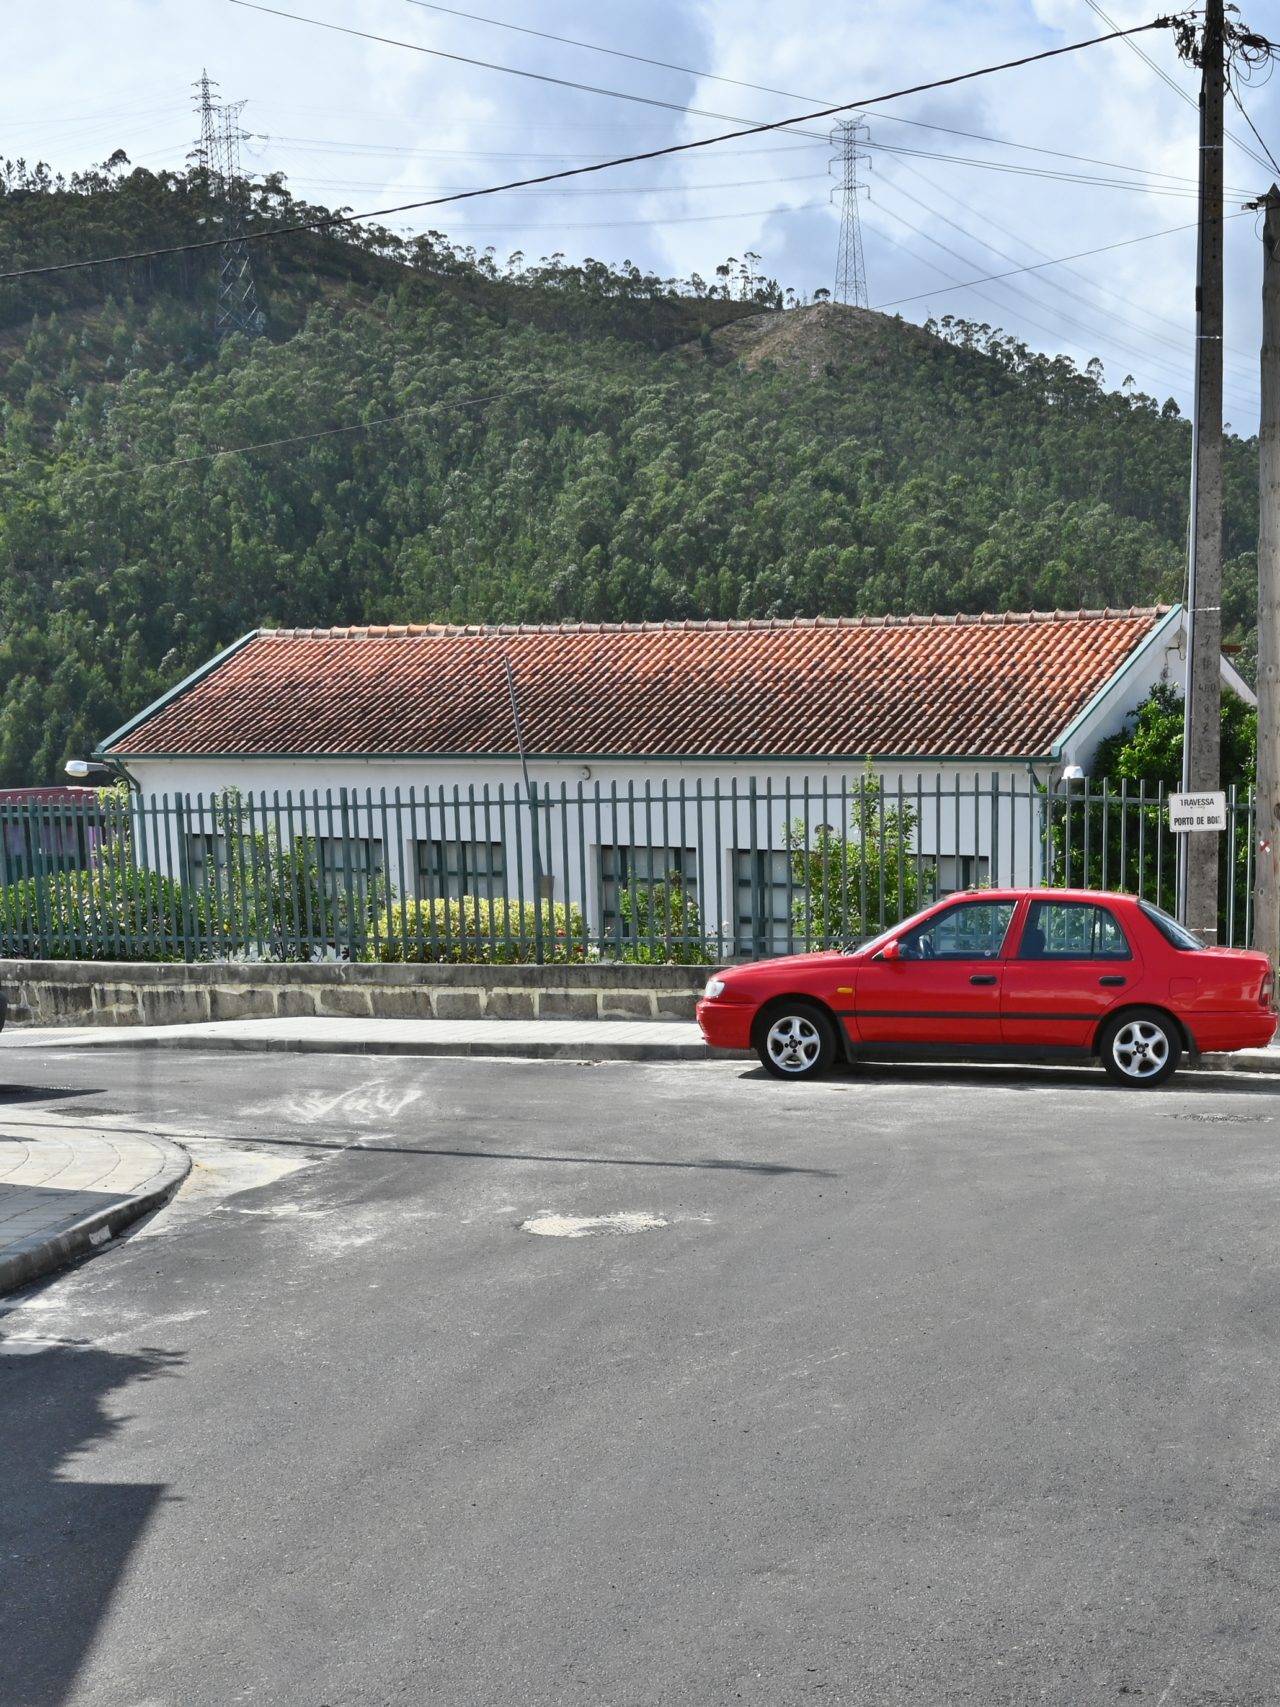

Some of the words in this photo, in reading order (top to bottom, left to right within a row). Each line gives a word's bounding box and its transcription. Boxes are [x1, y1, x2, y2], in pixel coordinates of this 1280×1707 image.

[1179, 798, 1215, 806] TRAVESSA
[1173, 817, 1194, 826] PORTO
[1197, 816, 1205, 825] DE
